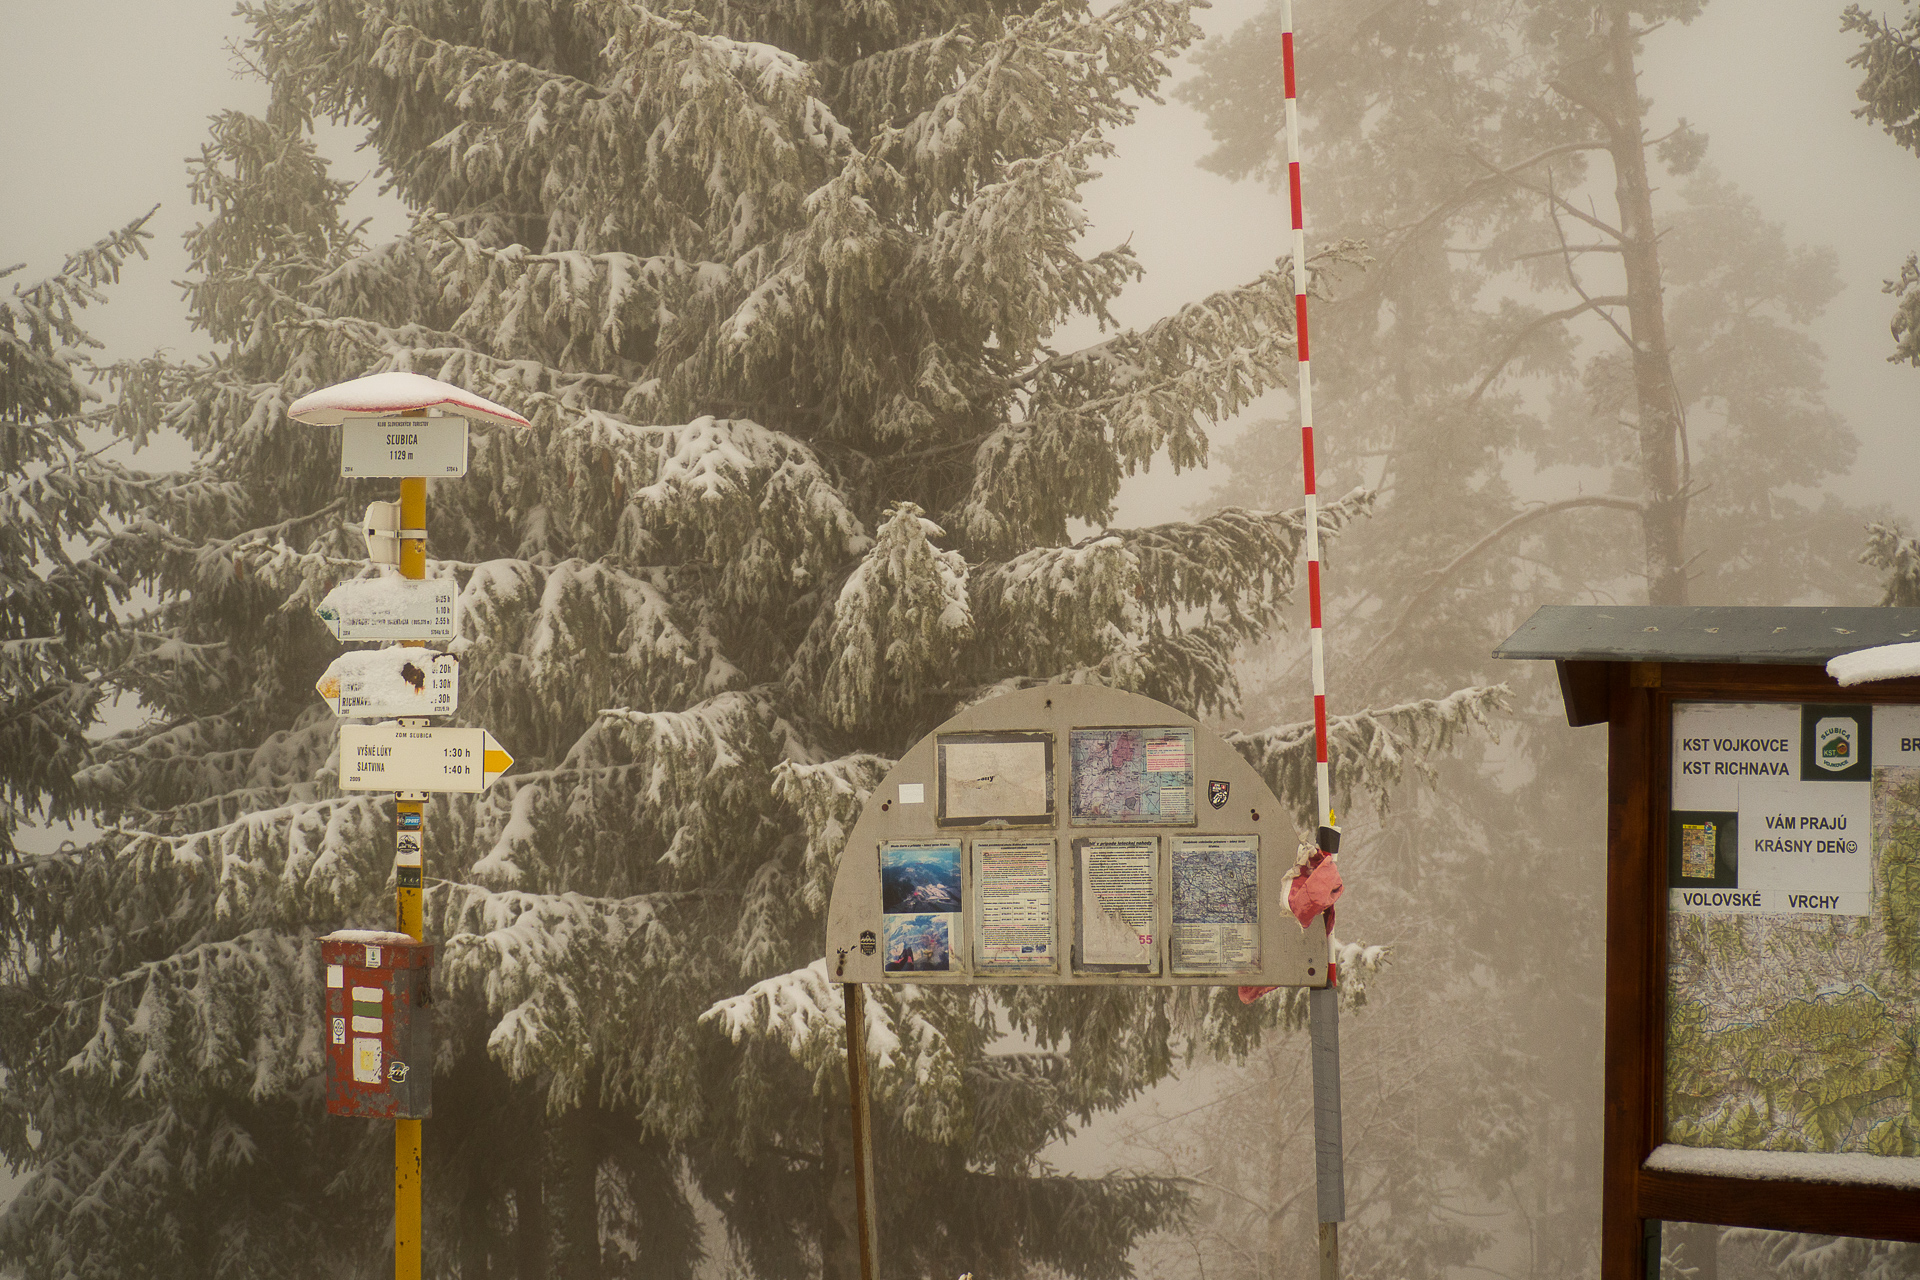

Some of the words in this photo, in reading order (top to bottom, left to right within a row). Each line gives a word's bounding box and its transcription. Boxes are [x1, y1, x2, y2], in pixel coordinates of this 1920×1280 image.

[390, 450, 406, 460] 1129
[408, 452, 414, 460] m
[435, 617, 446, 625] 2:55
[357, 744, 376, 757] VYŠNÉ
[376, 744, 392, 757] LÚKY
[443, 748, 463, 757] 1:30
[465, 748, 471, 757] h
[1683, 738, 1710, 752] KST
[1713, 738, 1789, 752] VOJKOVCE
[357, 761, 385, 772] SLATVINA
[443, 765, 462, 774] 1:40
[464, 765, 470, 774] h
[1682, 761, 1711, 775] KST
[1714, 761, 1790, 776] RICHNAVA
[1765, 813, 1796, 830] VÁM
[1800, 814, 1847, 830] PRAJÚ
[1755, 837, 1813, 853] KRÁSNY
[1682, 890, 1762, 906] VOLOVSKÉ
[1788, 894, 1840, 909] VRCHY
[1138, 934, 1153, 945] 55
